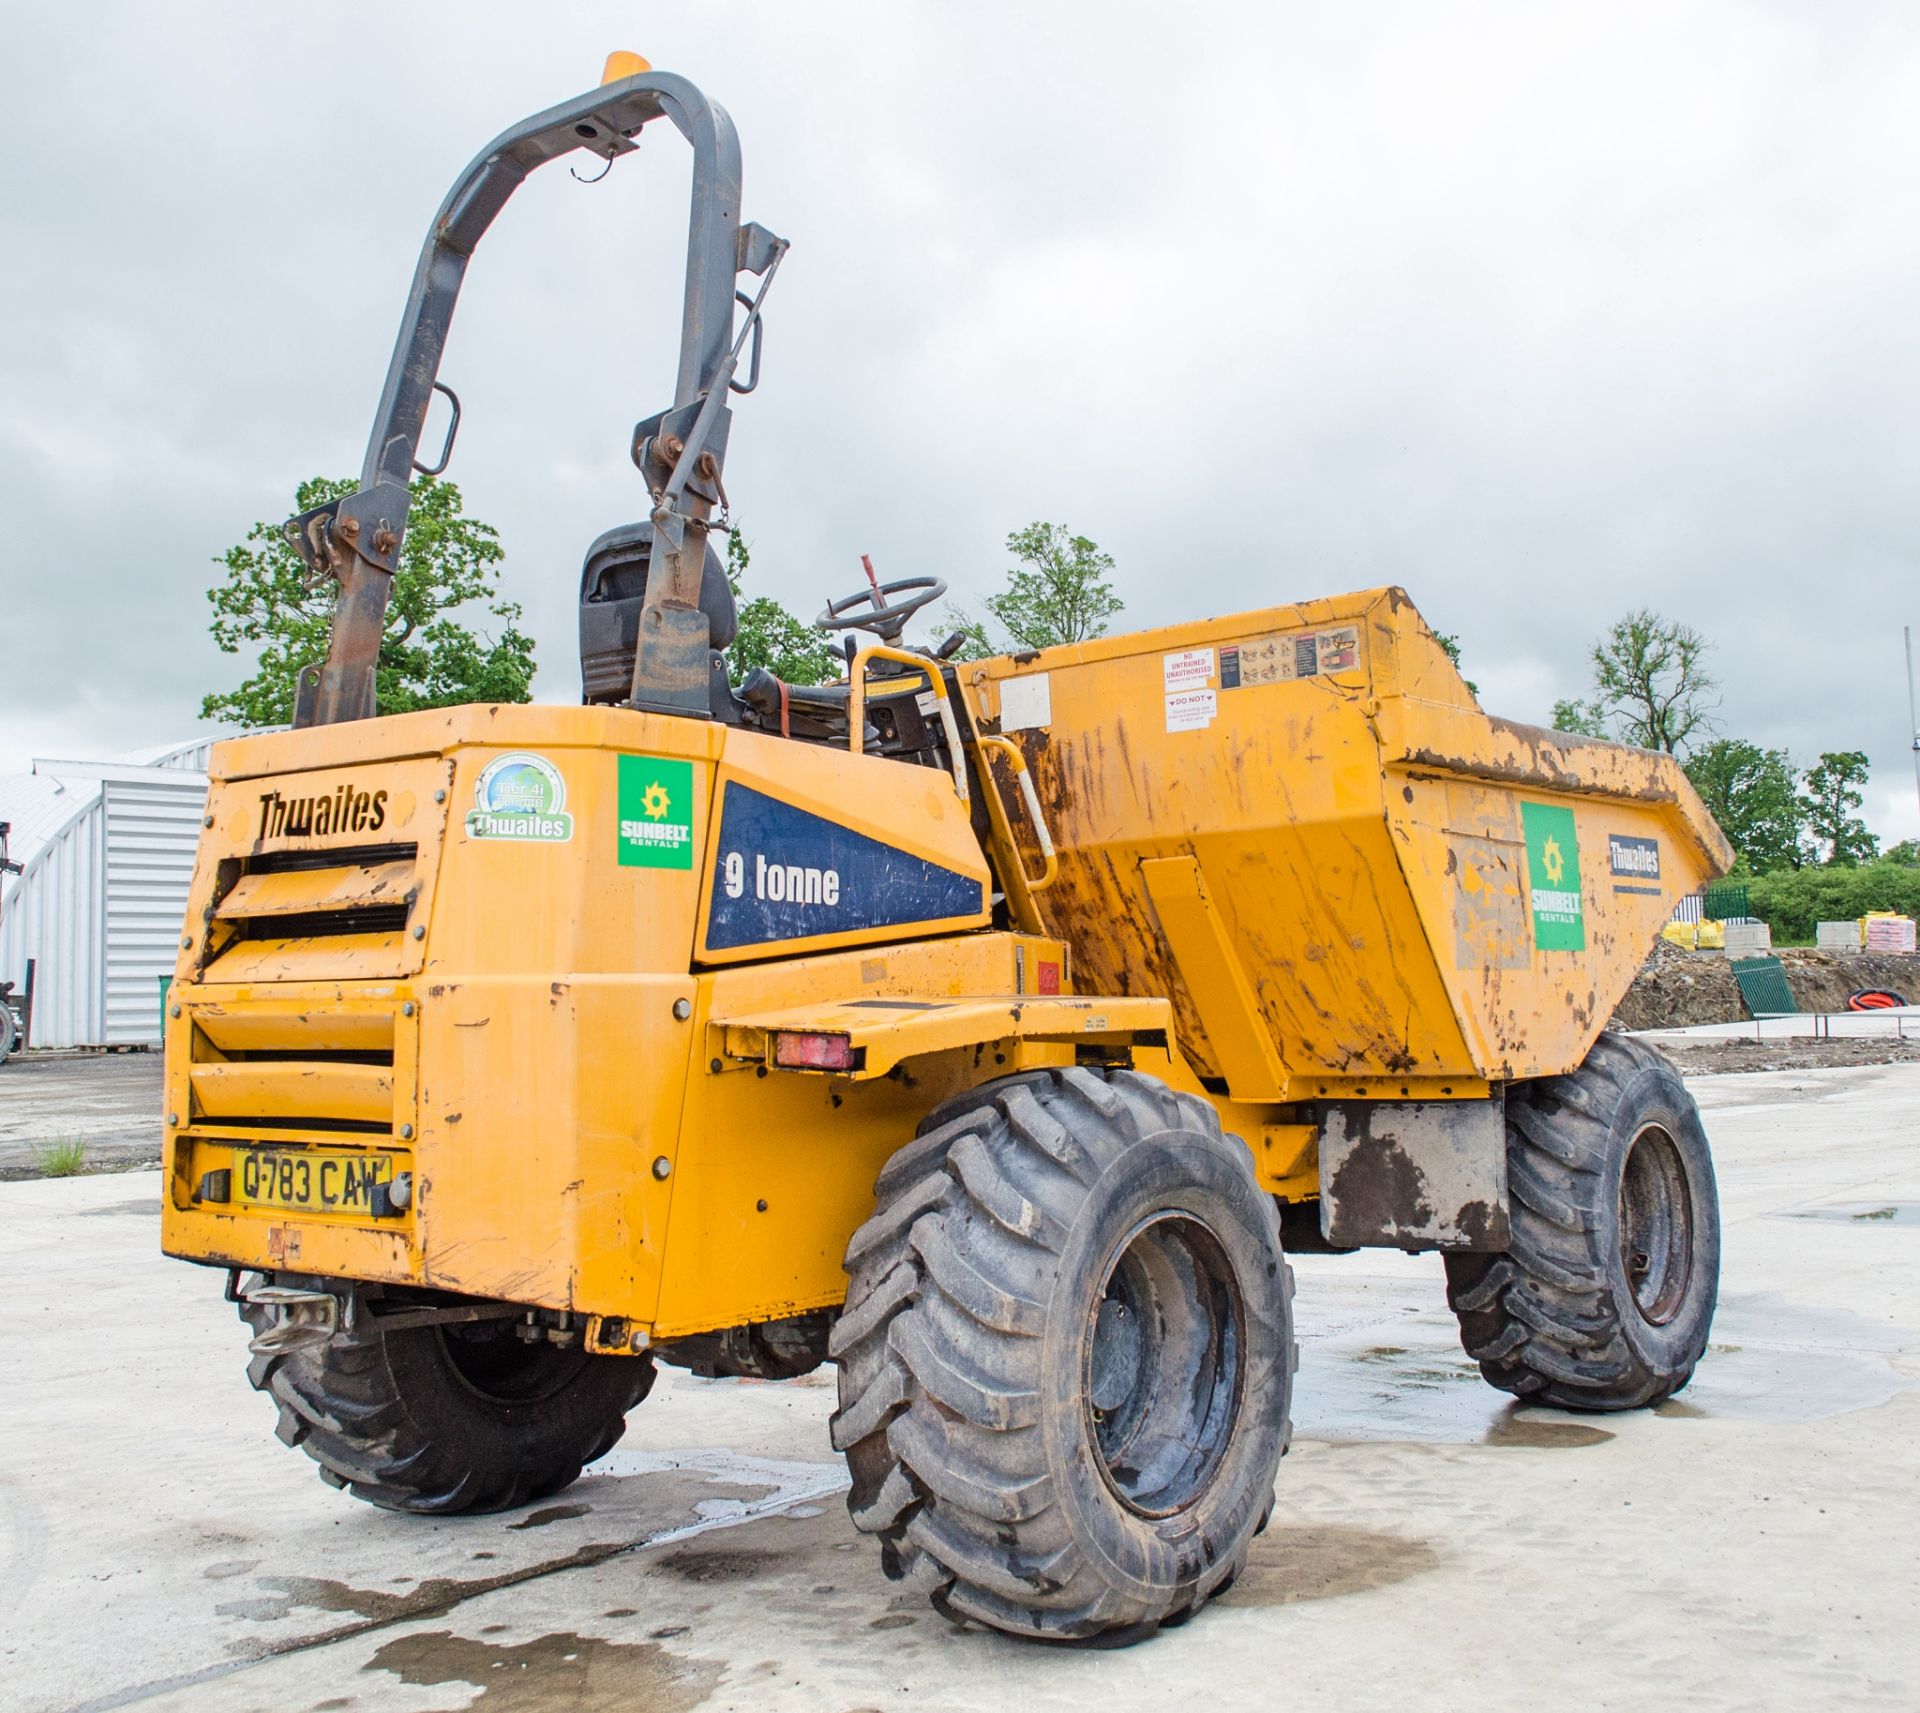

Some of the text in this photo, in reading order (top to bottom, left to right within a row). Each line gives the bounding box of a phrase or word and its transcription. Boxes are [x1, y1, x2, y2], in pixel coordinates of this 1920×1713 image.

[1166, 665, 1212, 679] UNAUTHORISED
[1171, 659, 1206, 670] UNTRAINED
[1189, 695, 1205, 703] NOT
[497, 782, 526, 794] Tier
[260, 784, 388, 841] Thwaites
[475, 815, 564, 837] Thwaites
[621, 820, 690, 842] SUNBELT
[630, 838, 680, 849] RENTALS
[1610, 841, 1658, 873] Thwaites
[725, 852, 840, 906] 9 tonne
[1531, 889, 1580, 914] SUNBELT
[1540, 912, 1575, 924] RENTALS
[319, 1160, 377, 1206] CAW
